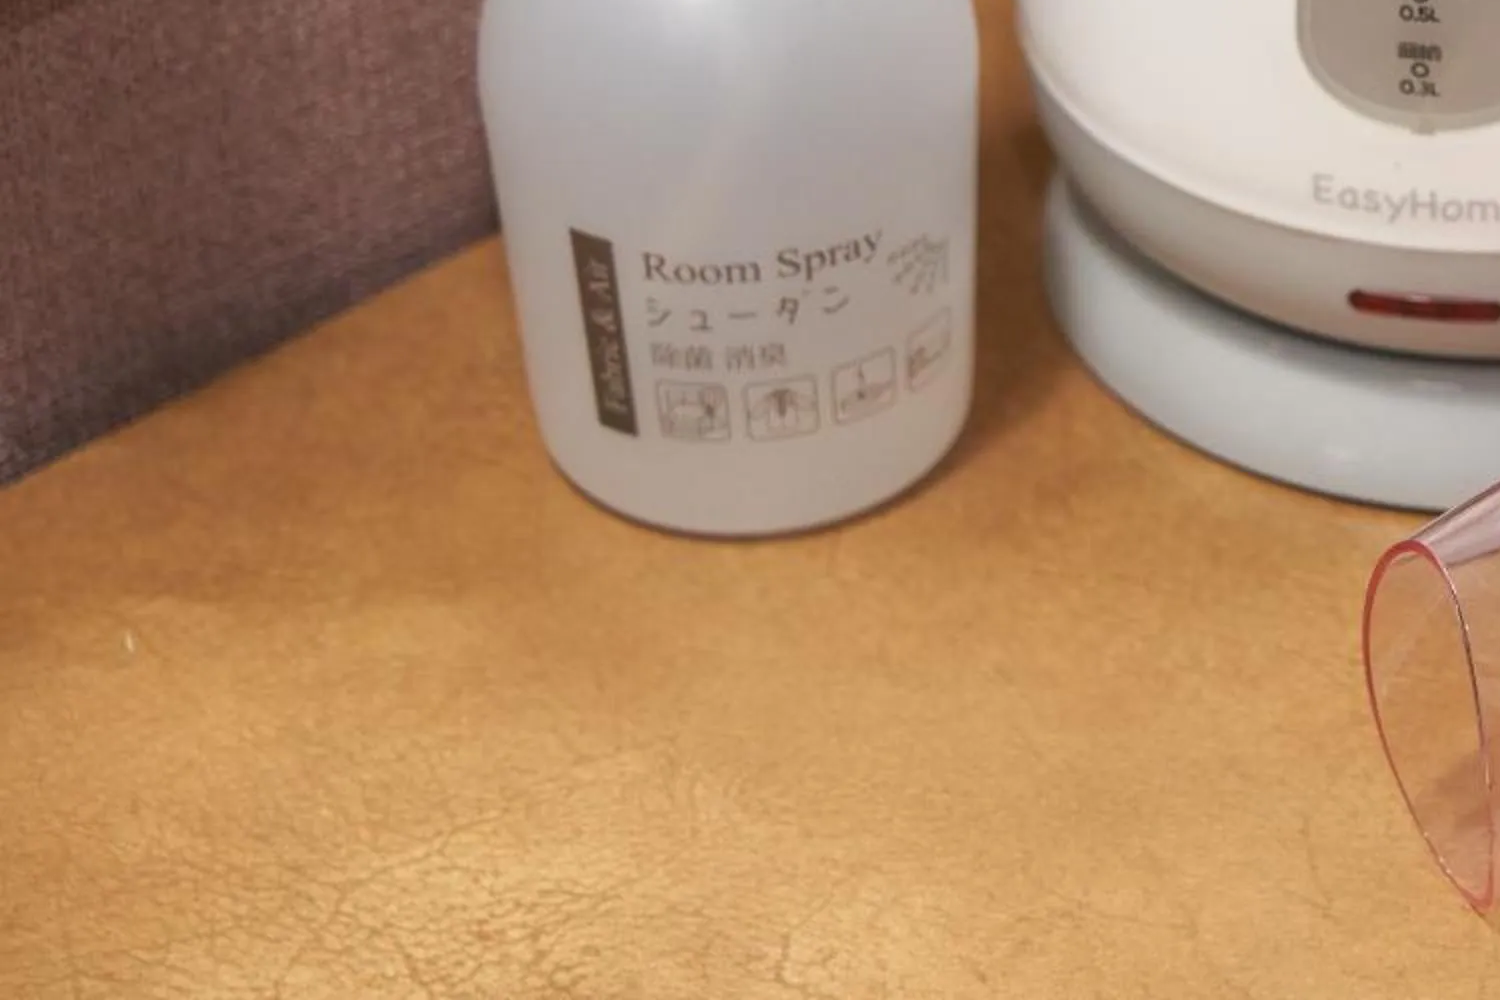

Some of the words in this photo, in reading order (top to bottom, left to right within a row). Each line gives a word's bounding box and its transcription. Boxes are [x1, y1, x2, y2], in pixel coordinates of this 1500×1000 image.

[1399, 4, 1440, 23] 0.5L
[643, 252, 761, 285] Room
[776, 228, 884, 281] Spray
